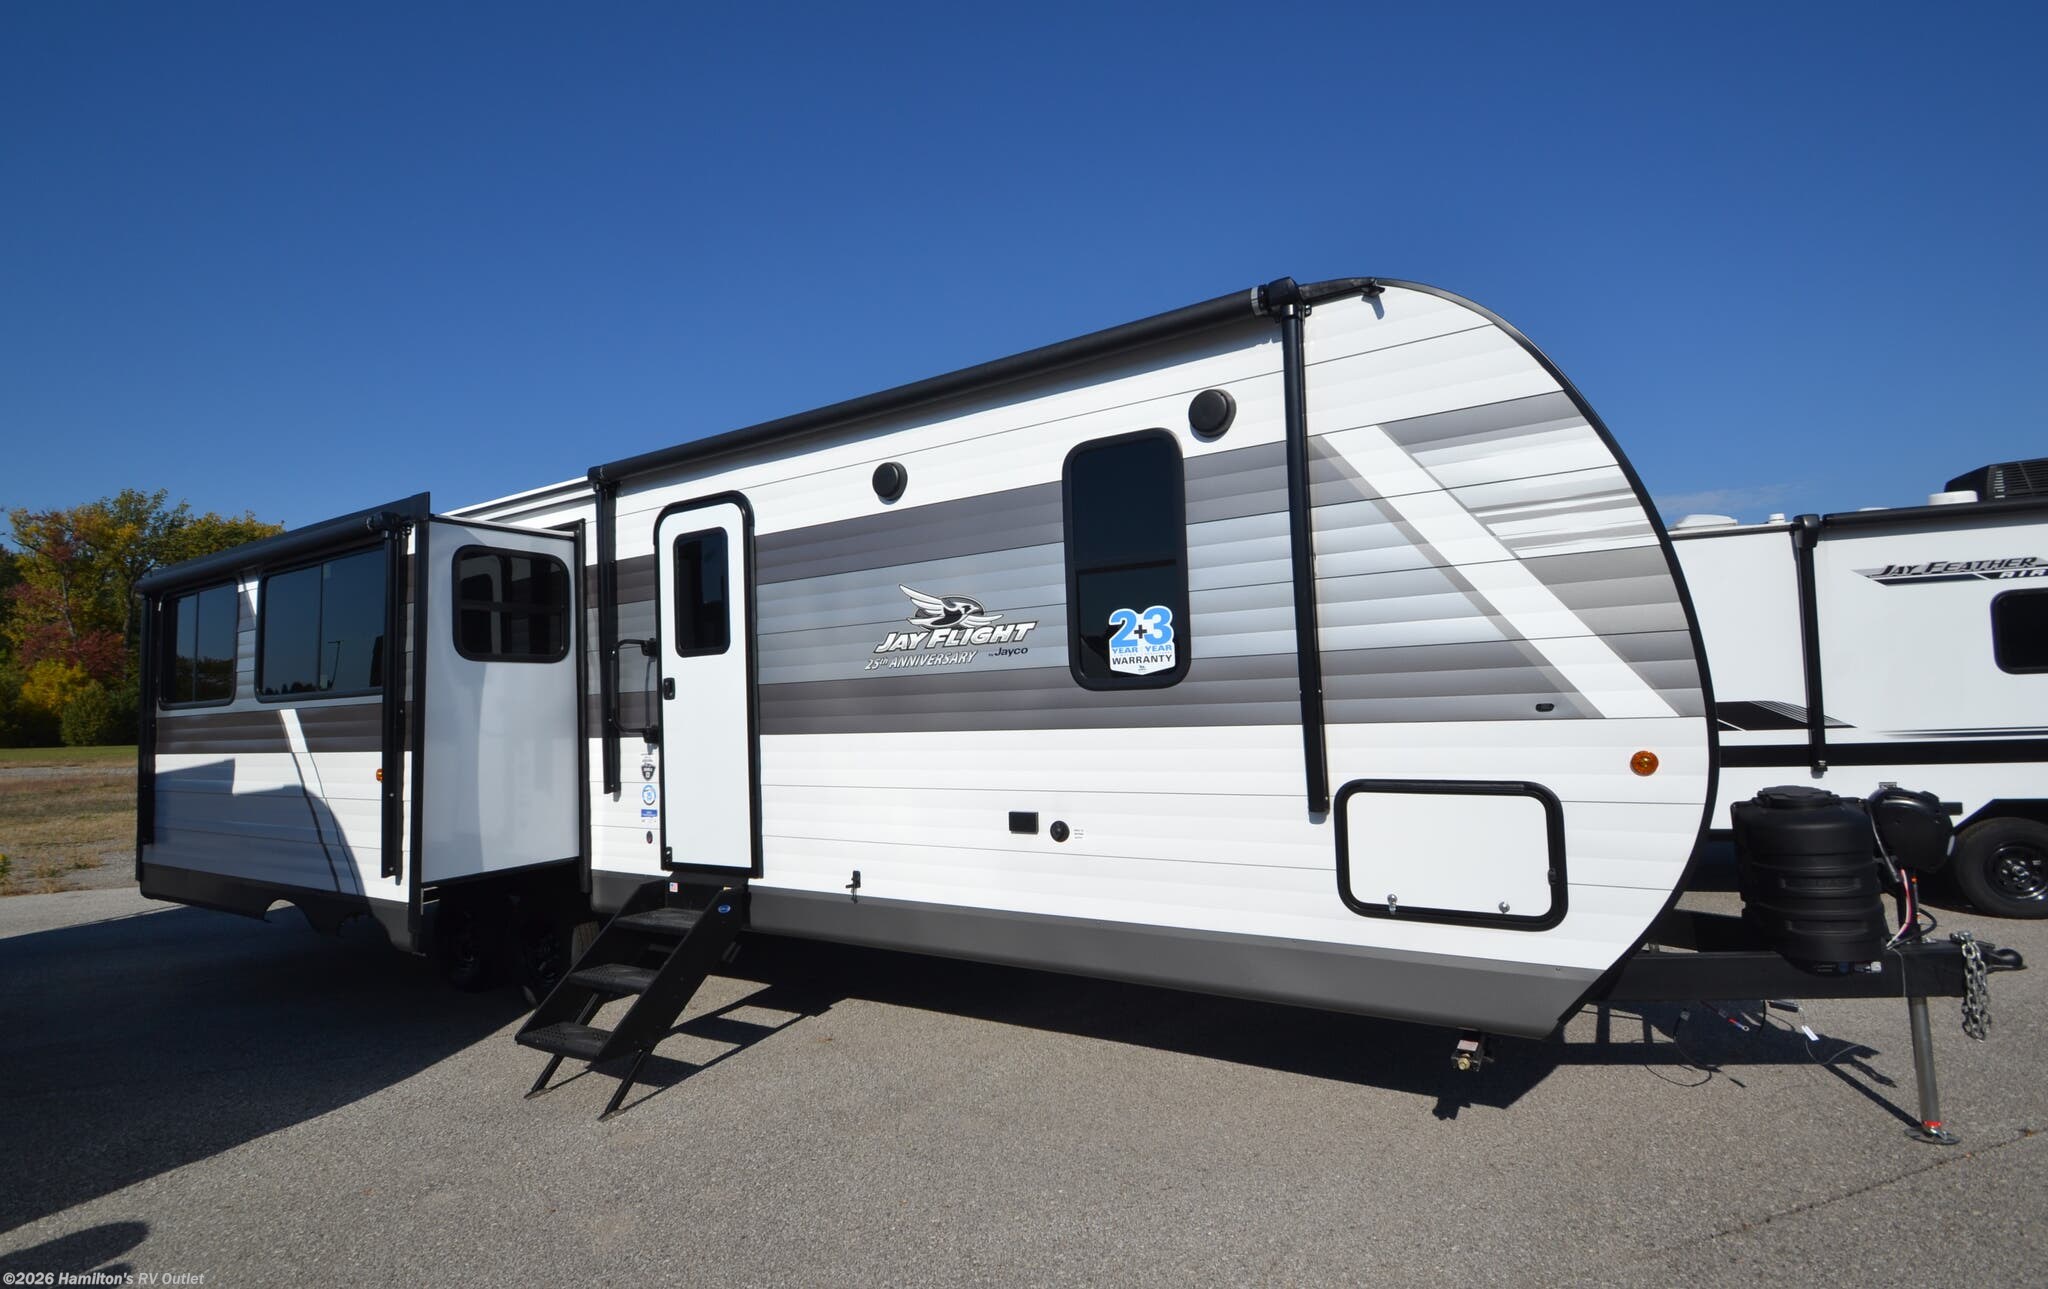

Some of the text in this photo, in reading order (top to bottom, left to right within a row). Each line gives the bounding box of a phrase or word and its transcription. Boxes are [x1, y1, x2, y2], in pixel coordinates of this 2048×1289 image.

[1875, 557, 2037, 576] JAY FEATHER
[874, 622, 1037, 652] JAY FLIGHT
[1111, 607, 1172, 647] 2+3
[864, 650, 979, 671] 25th ANNIVERSARY
[994, 646, 1029, 657] Jayco
[1112, 655, 1172, 665] WARRANTY
